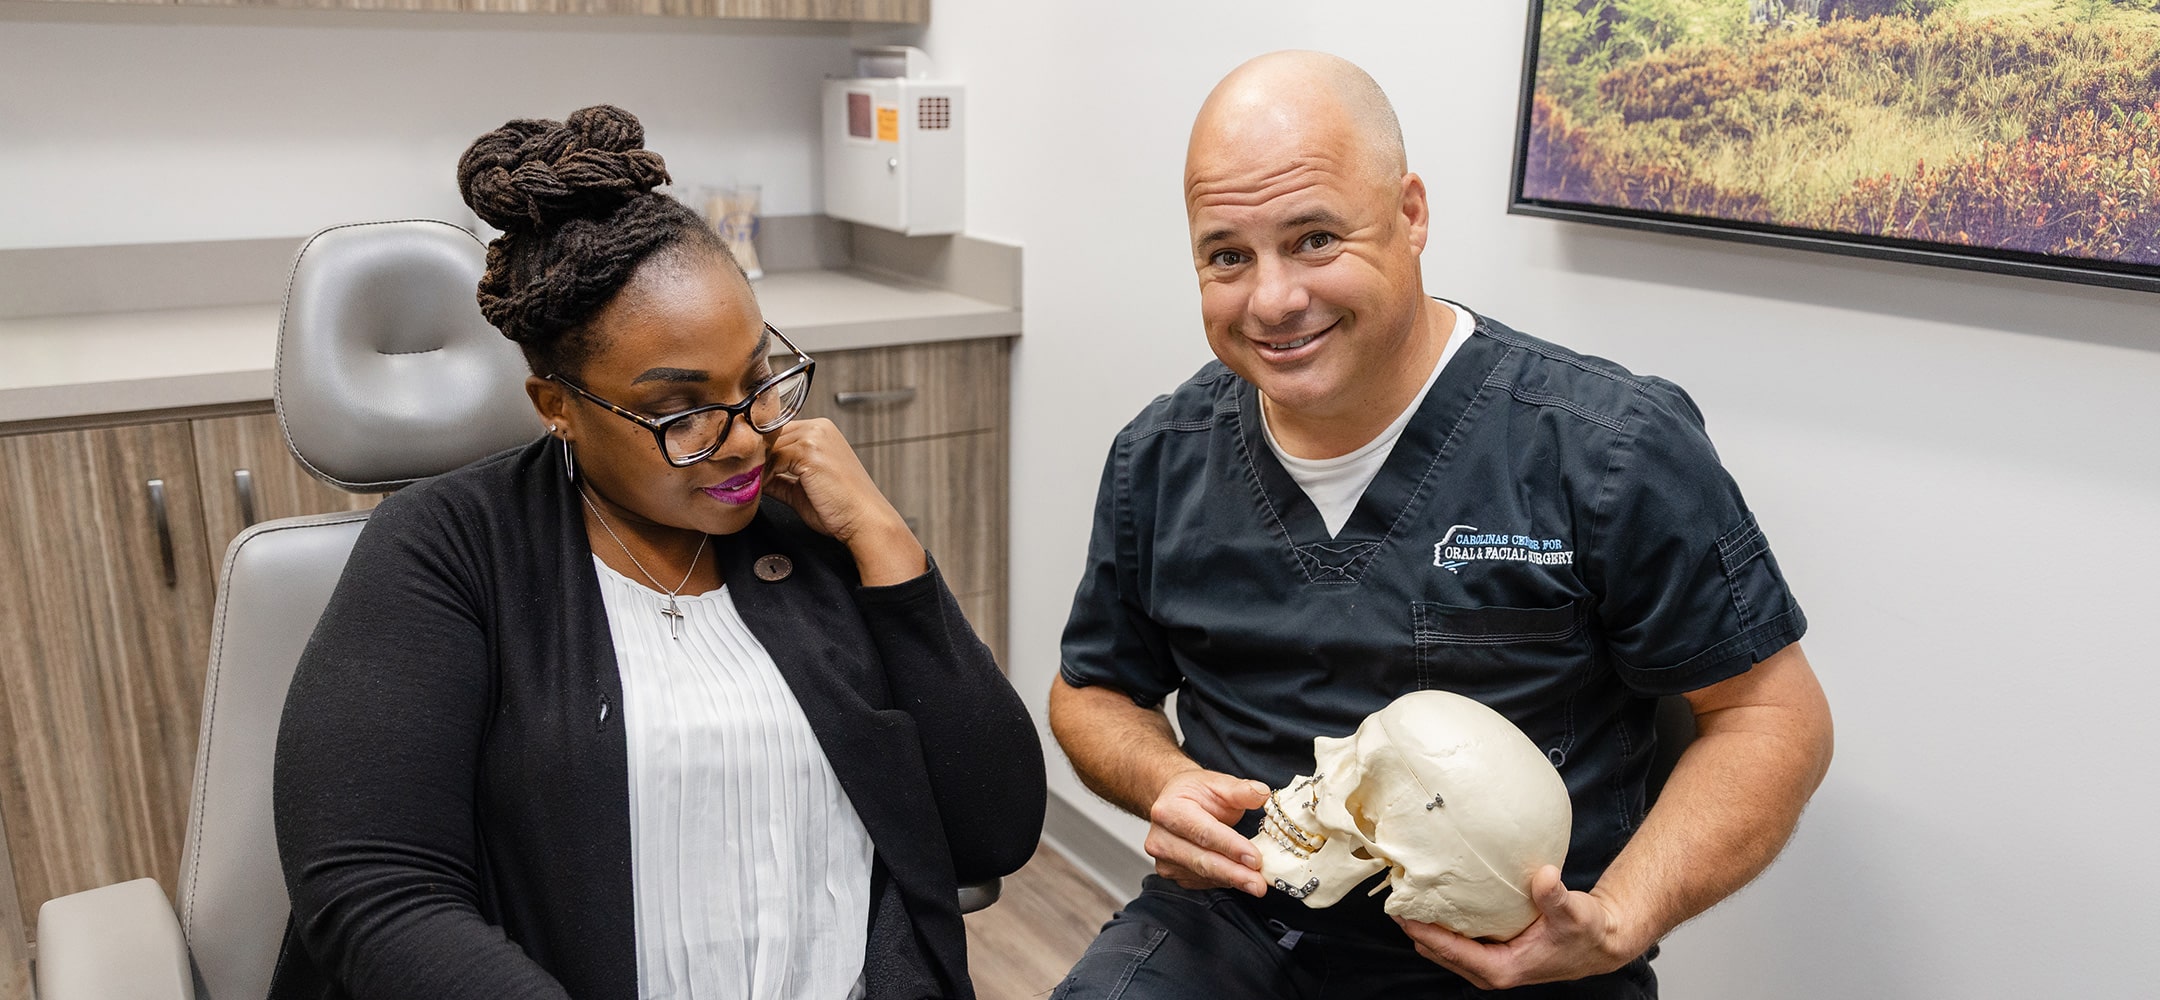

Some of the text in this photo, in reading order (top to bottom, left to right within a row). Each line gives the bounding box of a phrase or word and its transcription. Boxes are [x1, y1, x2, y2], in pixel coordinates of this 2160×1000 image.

[1456, 534, 1508, 545] CAROLINAS
[1542, 539, 1562, 550] FOR
[1445, 546, 1475, 560] ORAL
[1476, 547, 1483, 560] &
[1484, 546, 1527, 561] FACIAL
